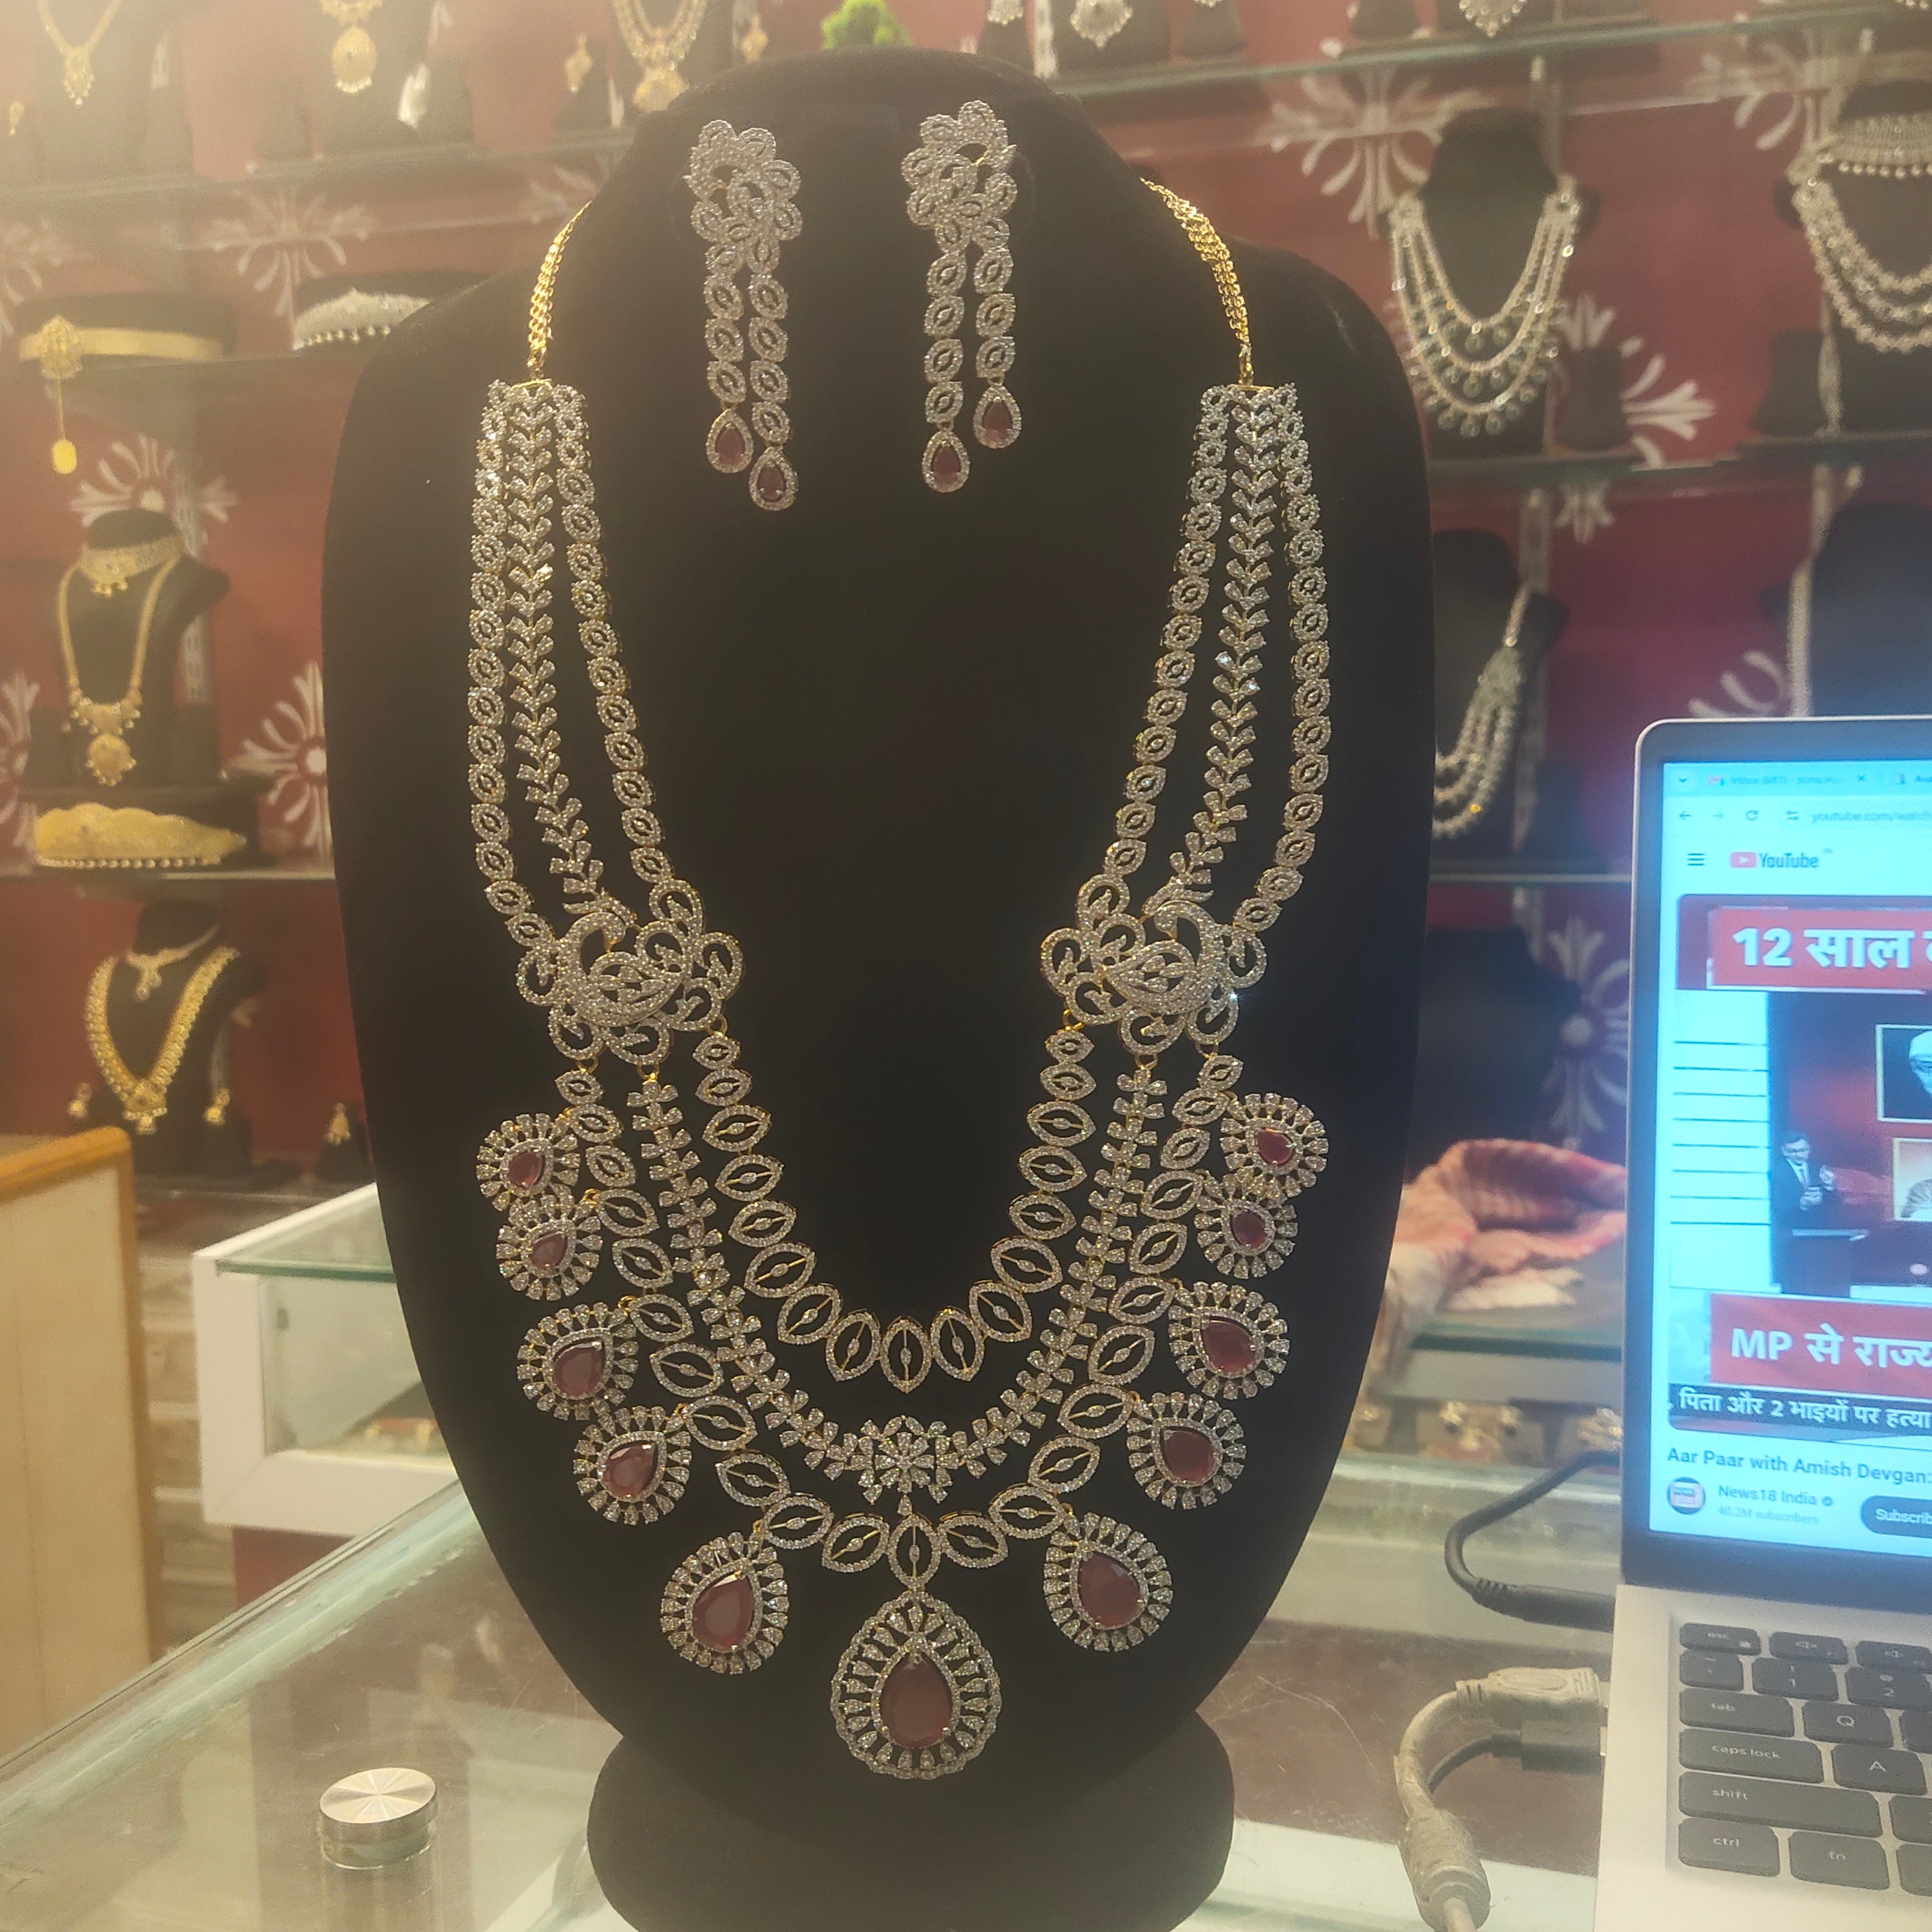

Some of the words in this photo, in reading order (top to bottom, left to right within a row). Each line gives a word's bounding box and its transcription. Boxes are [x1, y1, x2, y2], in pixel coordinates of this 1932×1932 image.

[1759, 852, 1819, 867] YouTube
[1733, 927, 1794, 967] 12
[1803, 928, 1917, 969] साल
[1731, 1328, 1793, 1360] MP
[1804, 1322, 1844, 1365] से
[1680, 1387, 1722, 1412] पिता
[1727, 1392, 1765, 1414] और
[1771, 1399, 1785, 1417] 2
[1788, 1399, 1850, 1423] भाइयों
[1853, 1406, 1881, 1424] पर
[1667, 1448, 1698, 1463] Aar
[1703, 1450, 1745, 1467] Paar
[1750, 1455, 1788, 1471] with
[1793, 1459, 1852, 1477] Amish
[1719, 1485, 1776, 1501] News18
[1781, 1490, 1817, 1505] India
[1756, 1510, 1819, 1524] subscribers
[1788, 1678, 1796, 1687] 1
[1883, 1688, 1895, 1697] 2
[1711, 1702, 1736, 1712] tab
[1836, 1715, 1855, 1728] Q
[1712, 1745, 1747, 1756] caps
[1750, 1748, 1781, 1759] lock
[1869, 1760, 1887, 1772] A
[1712, 1789, 1748, 1801] shift
[1713, 1837, 1740, 1847] ctrl
[1828, 1850, 1846, 1861] fn
